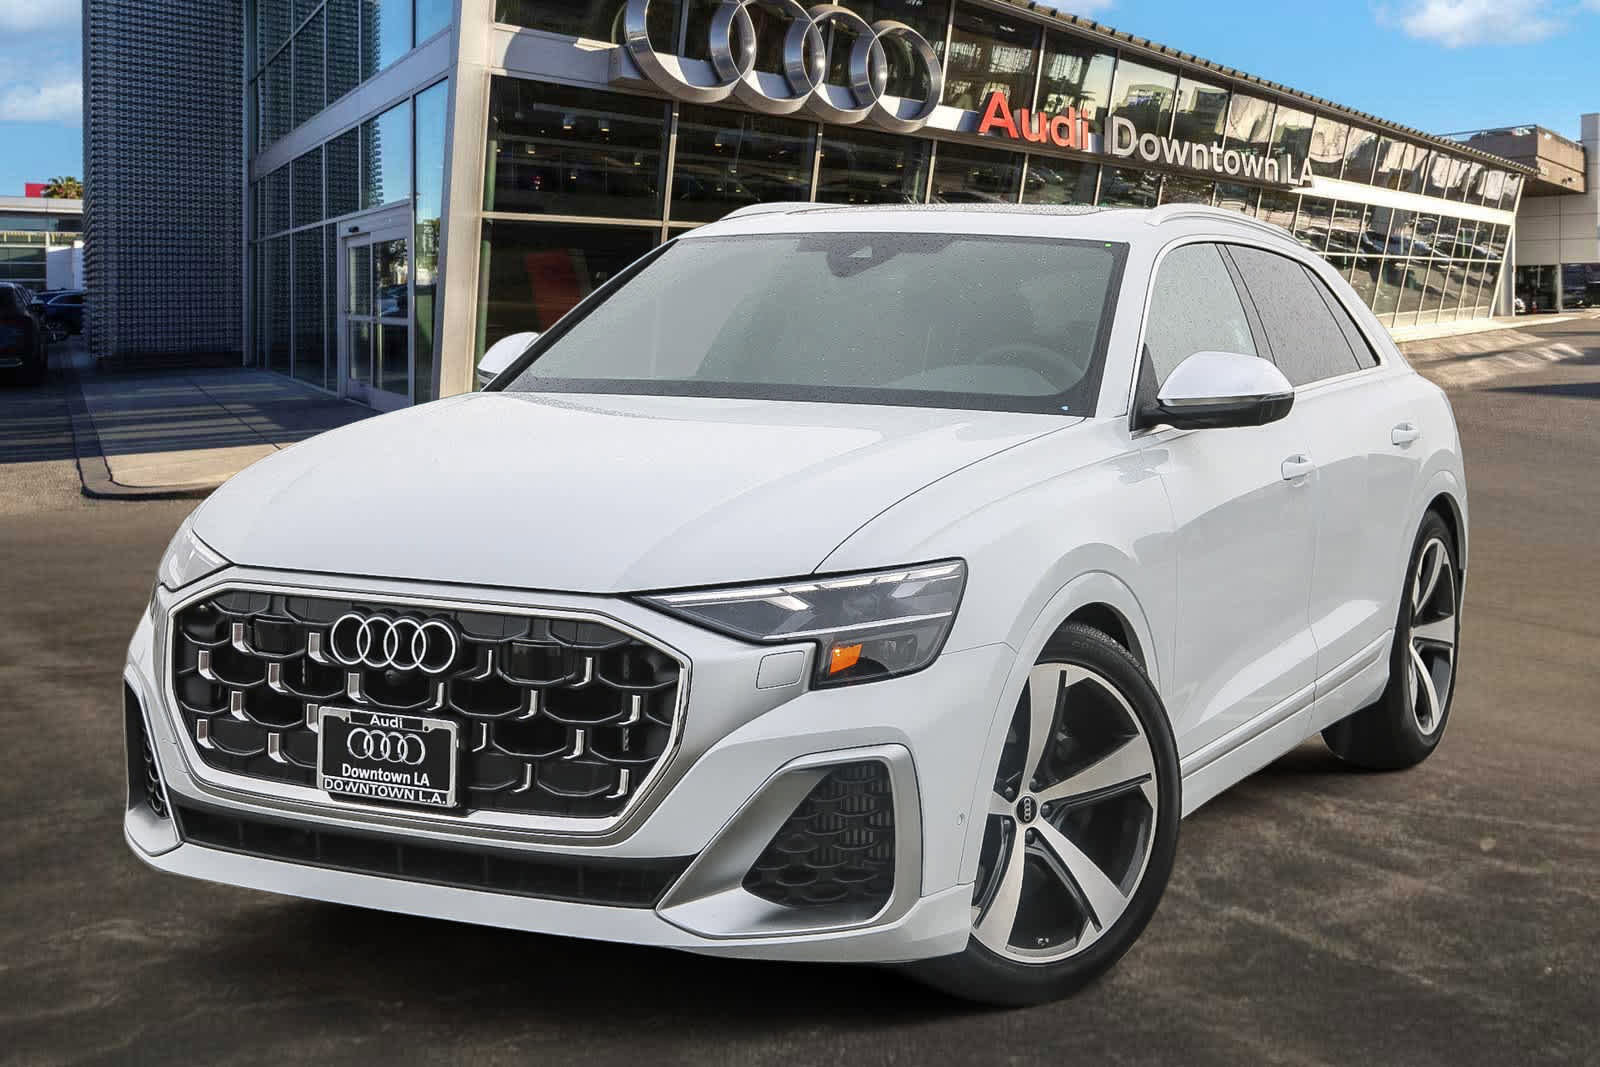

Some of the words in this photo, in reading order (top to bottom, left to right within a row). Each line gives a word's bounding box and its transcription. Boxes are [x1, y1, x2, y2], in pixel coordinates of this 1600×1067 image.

[978, 91, 1088, 150] Audi
[1109, 116, 1279, 182] Downtown
[1286, 153, 1315, 187] LA
[370, 714, 403, 728] Audi
[342, 763, 411, 784] Downtown
[414, 772, 430, 786] LA
[324, 778, 414, 800] DOWNTOWN
[418, 791, 446, 804] L.A.
